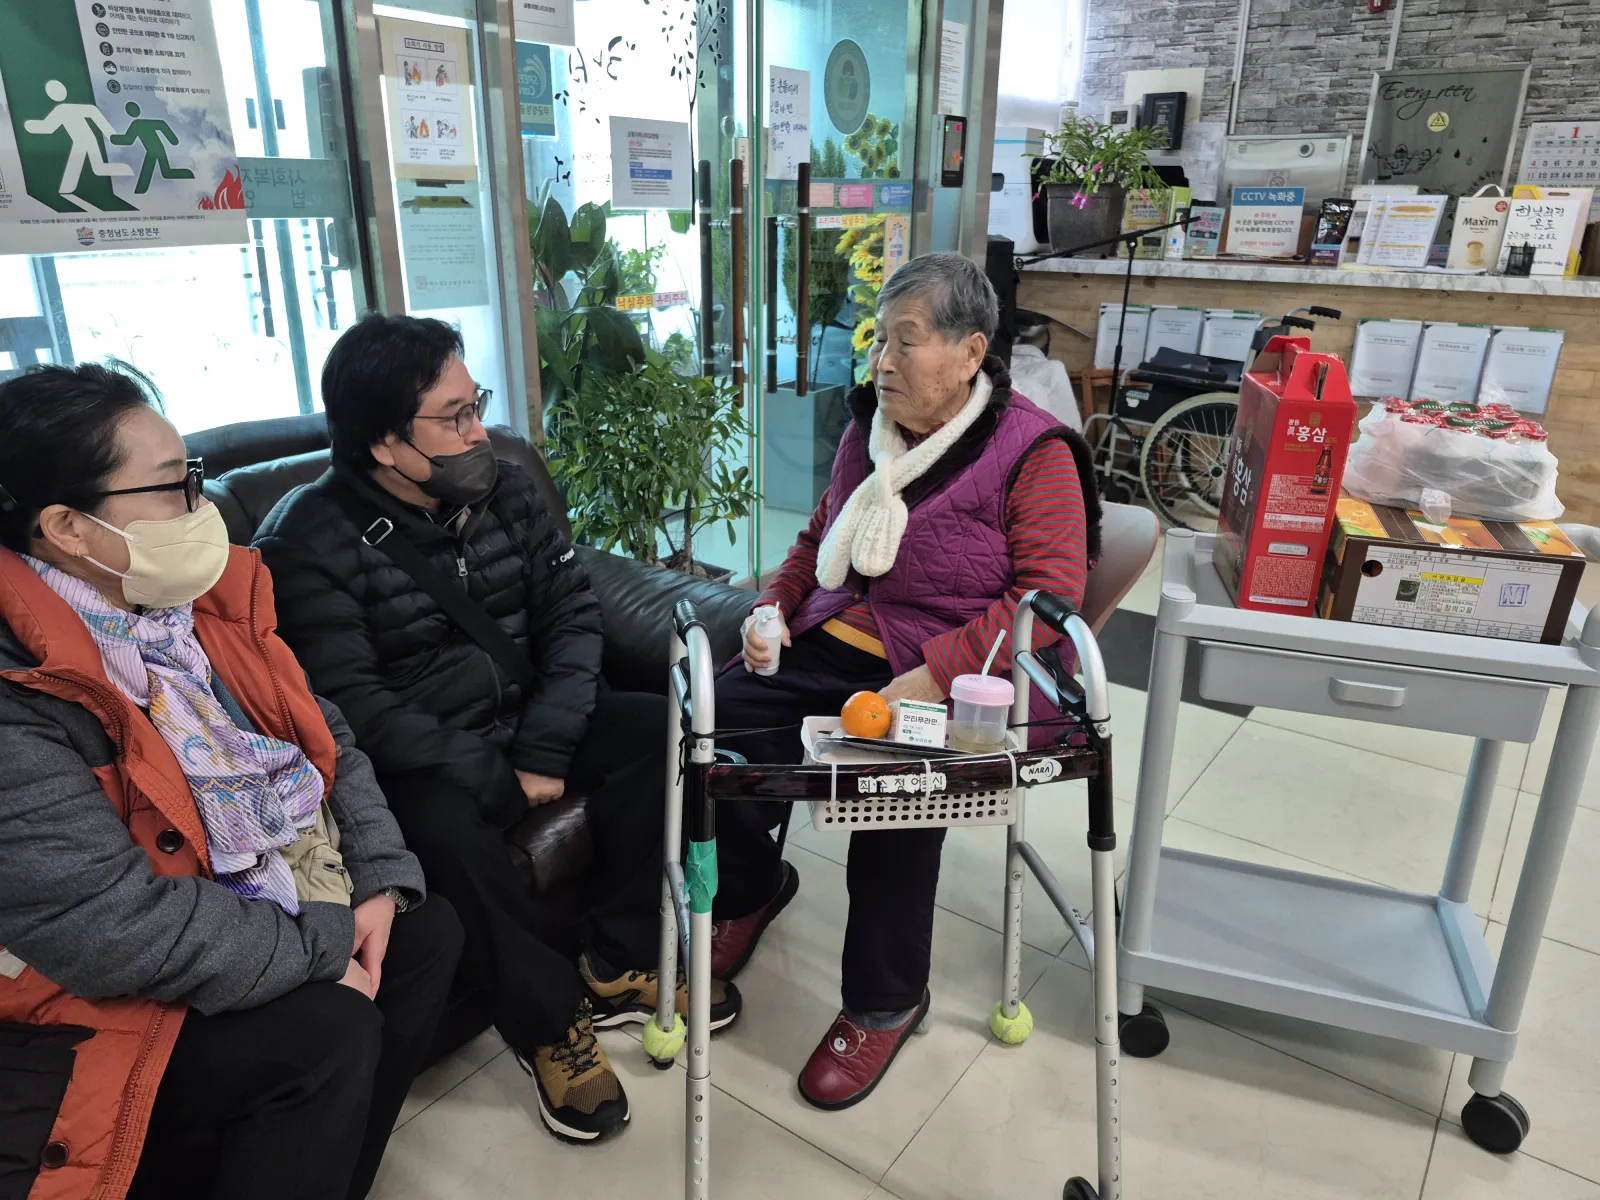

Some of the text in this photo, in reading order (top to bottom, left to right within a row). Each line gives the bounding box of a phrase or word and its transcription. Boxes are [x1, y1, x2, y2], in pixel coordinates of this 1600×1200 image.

[1571, 126, 1580, 138] 1
[1241, 191, 1295, 202] CCTV 녹화중
[1462, 216, 1498, 226] Maxim
[1530, 218, 1556, 230] 온도
[98, 228, 160, 238] 충청남도 소방본부
[618, 293, 686, 309] 낙상주의 유리주의
[1296, 426, 1327, 443] 홍삼
[904, 714, 938, 725] 안티푸라민
